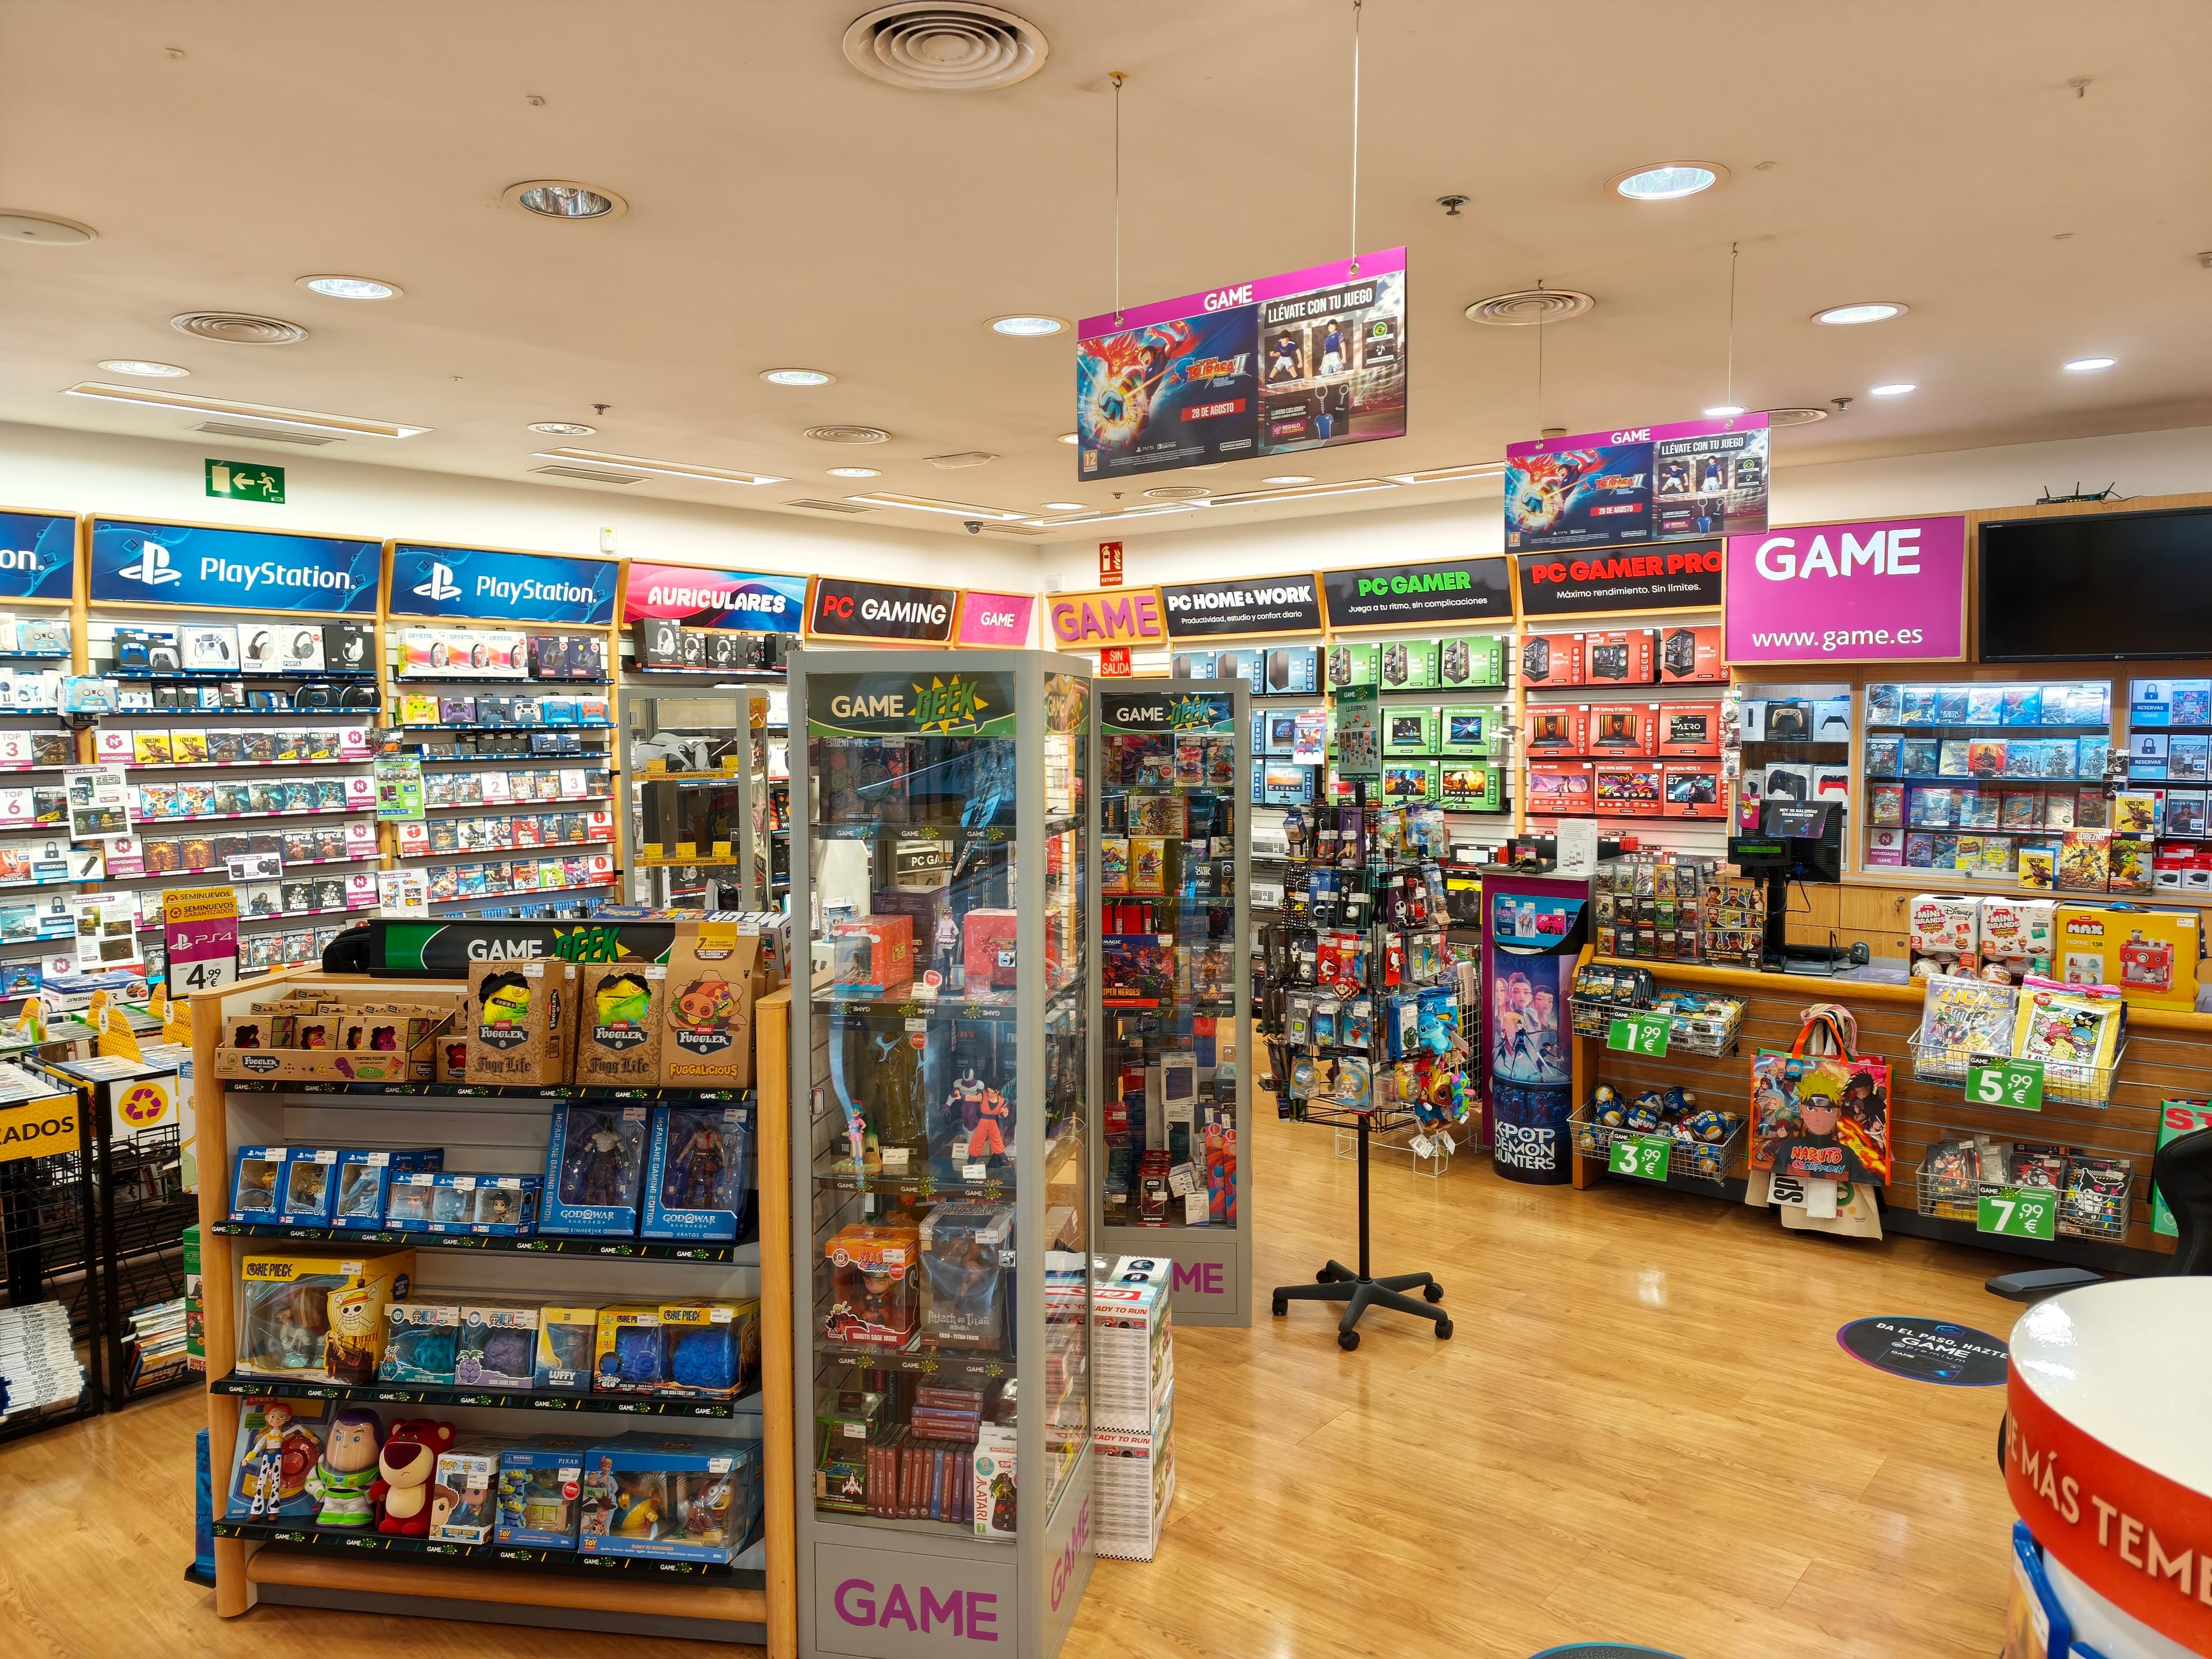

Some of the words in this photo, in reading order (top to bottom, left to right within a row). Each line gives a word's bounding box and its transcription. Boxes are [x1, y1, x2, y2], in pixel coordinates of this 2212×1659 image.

[1204, 284, 1253, 311] GAME
[1268, 301, 1306, 323] LLÉVATE
[1308, 298, 1327, 315] CON
[1329, 294, 1342, 310] TU
[1343, 287, 1373, 308] JUEGO
[1192, 409, 1200, 418] 28
[1201, 407, 1209, 416] DE
[1210, 402, 1234, 415] AGOSTO
[1611, 428, 1651, 444] GAME
[1661, 442, 1691, 455] LLÉVATE
[1692, 441, 1708, 452] CON
[1709, 440, 1719, 450] TU
[1721, 437, 1744, 449] JUEGO
[1085, 451, 1097, 465] 12
[1614, 505, 1633, 513] AGOSTO
[1510, 533, 1520, 543] 12
[1755, 528, 1921, 581] GAME
[200, 556, 350, 591] PlayStation
[1532, 563, 1566, 584] PC
[1569, 556, 1665, 581] GAMER
[1667, 550, 1722, 574] PRO
[476, 575, 594, 605] PlayStation
[1358, 577, 1388, 597] PC
[1391, 571, 1472, 594] GAMER
[1556, 589, 1592, 599] Máximo
[1593, 585, 1650, 596] rendimiento.
[1652, 584, 1666, 593] Sin
[1668, 582, 1701, 593] límites.
[647, 586, 786, 613] AURICULARES
[1167, 594, 1192, 612] PC
[1349, 605, 1372, 613] Juega
[1379, 603, 1388, 611] tu
[1389, 601, 1411, 611] ritmo,
[1412, 600, 1423, 608] sin
[1425, 597, 1488, 609] complicaciones
[823, 595, 854, 618] PC
[861, 599, 946, 625] GAMING
[1051, 595, 1160, 641] GAME
[1181, 615, 1226, 624] Productividad,
[1227, 613, 1251, 622] estudio
[1257, 611, 1282, 620] confort
[1282, 609, 1302, 619] diario
[980, 612, 1015, 628] GAME
[1752, 627, 1923, 652] www.game.es
[1109, 650, 1123, 662] SIN
[1102, 662, 1130, 675] SALIDA
[831, 695, 904, 718] GAME
[914, 680, 978, 724] GEEK
[1116, 707, 1164, 721] GAME
[1171, 698, 1211, 725] GEEK
[6, 741, 18, 757] 3
[491, 782, 501, 793] 2
[570, 777, 578, 789] 3
[8, 799, 21, 815] 6
[2077, 832, 2105, 841] LOBEZNO
[180, 891, 230, 900] SEMINUEVOS
[184, 902, 234, 912] SEMINUEVOS
[184, 907, 234, 918] GARANTIZADOS
[1915, 916, 1946, 925] BRANDS
[1988, 921, 2020, 929] BRANDS
[2067, 923, 2104, 935] MAX
[195, 932, 233, 945] PS4
[467, 939, 543, 960] GAME
[555, 926, 621, 963] GEEK
[210, 978, 218, 987] €
[1118, 988, 1141, 997] HEROES
[1940, 987, 1998, 1008] LIGA
[480, 1028, 527, 1040] FUGGLER
[596, 1028, 646, 1041] FUGGLER
[680, 1032, 729, 1044] FUGGLER
[1644, 1039, 1654, 1052] €
[244, 1056, 277, 1066] FUGGLER
[475, 1056, 505, 1073] Fugg
[506, 1056, 532, 1073] Life
[589, 1057, 619, 1074] Fugg
[620, 1056, 649, 1073] Life
[669, 1063, 738, 1077] FUGGALICIOUS
[2013, 1090, 2024, 1104] €
[1495, 1134, 1555, 1159] DEMON
[1495, 1150, 1556, 1171] HUNTERS
[1791, 1146, 1843, 1164] NARUTO
[547, 1160, 558, 1190] GAMING
[1645, 1162, 1654, 1176] €
[1802, 1162, 1846, 1175] SHIPPUDEN
[649, 1164, 660, 1194] GAMING
[544, 1191, 553, 1221] EDITION
[646, 1195, 656, 1226] EDITION
[560, 1210, 583, 1219] GOD
[593, 1211, 615, 1220] WAR
[2024, 1219, 2037, 1234] €
[268, 1263, 292, 1277] PIECE
[1173, 1262, 1224, 1294] ME
[682, 1310, 700, 1321] PIECE
[928, 1309, 956, 1325] Attack
[958, 1316, 965, 1324] on
[965, 1313, 992, 1325] Titan
[853, 1333, 870, 1342] NARUTO
[884, 1335, 897, 1343] MODE
[1876, 1323, 1894, 1331] DA
[1898, 1328, 1914, 1336] EL
[1919, 1332, 1956, 1347] PASO,
[1963, 1343, 2009, 1359] HAZTE
[1901, 1337, 1971, 1358] GAME
[549, 1370, 575, 1380] LUFFY
[1094, 1434, 1116, 1442] EADY
[2021, 1433, 2080, 1525] MÁS
[976, 1493, 988, 1521] ATARI
[1051, 1494, 1090, 1612] GAME
[834, 1578, 998, 1642] GAME
